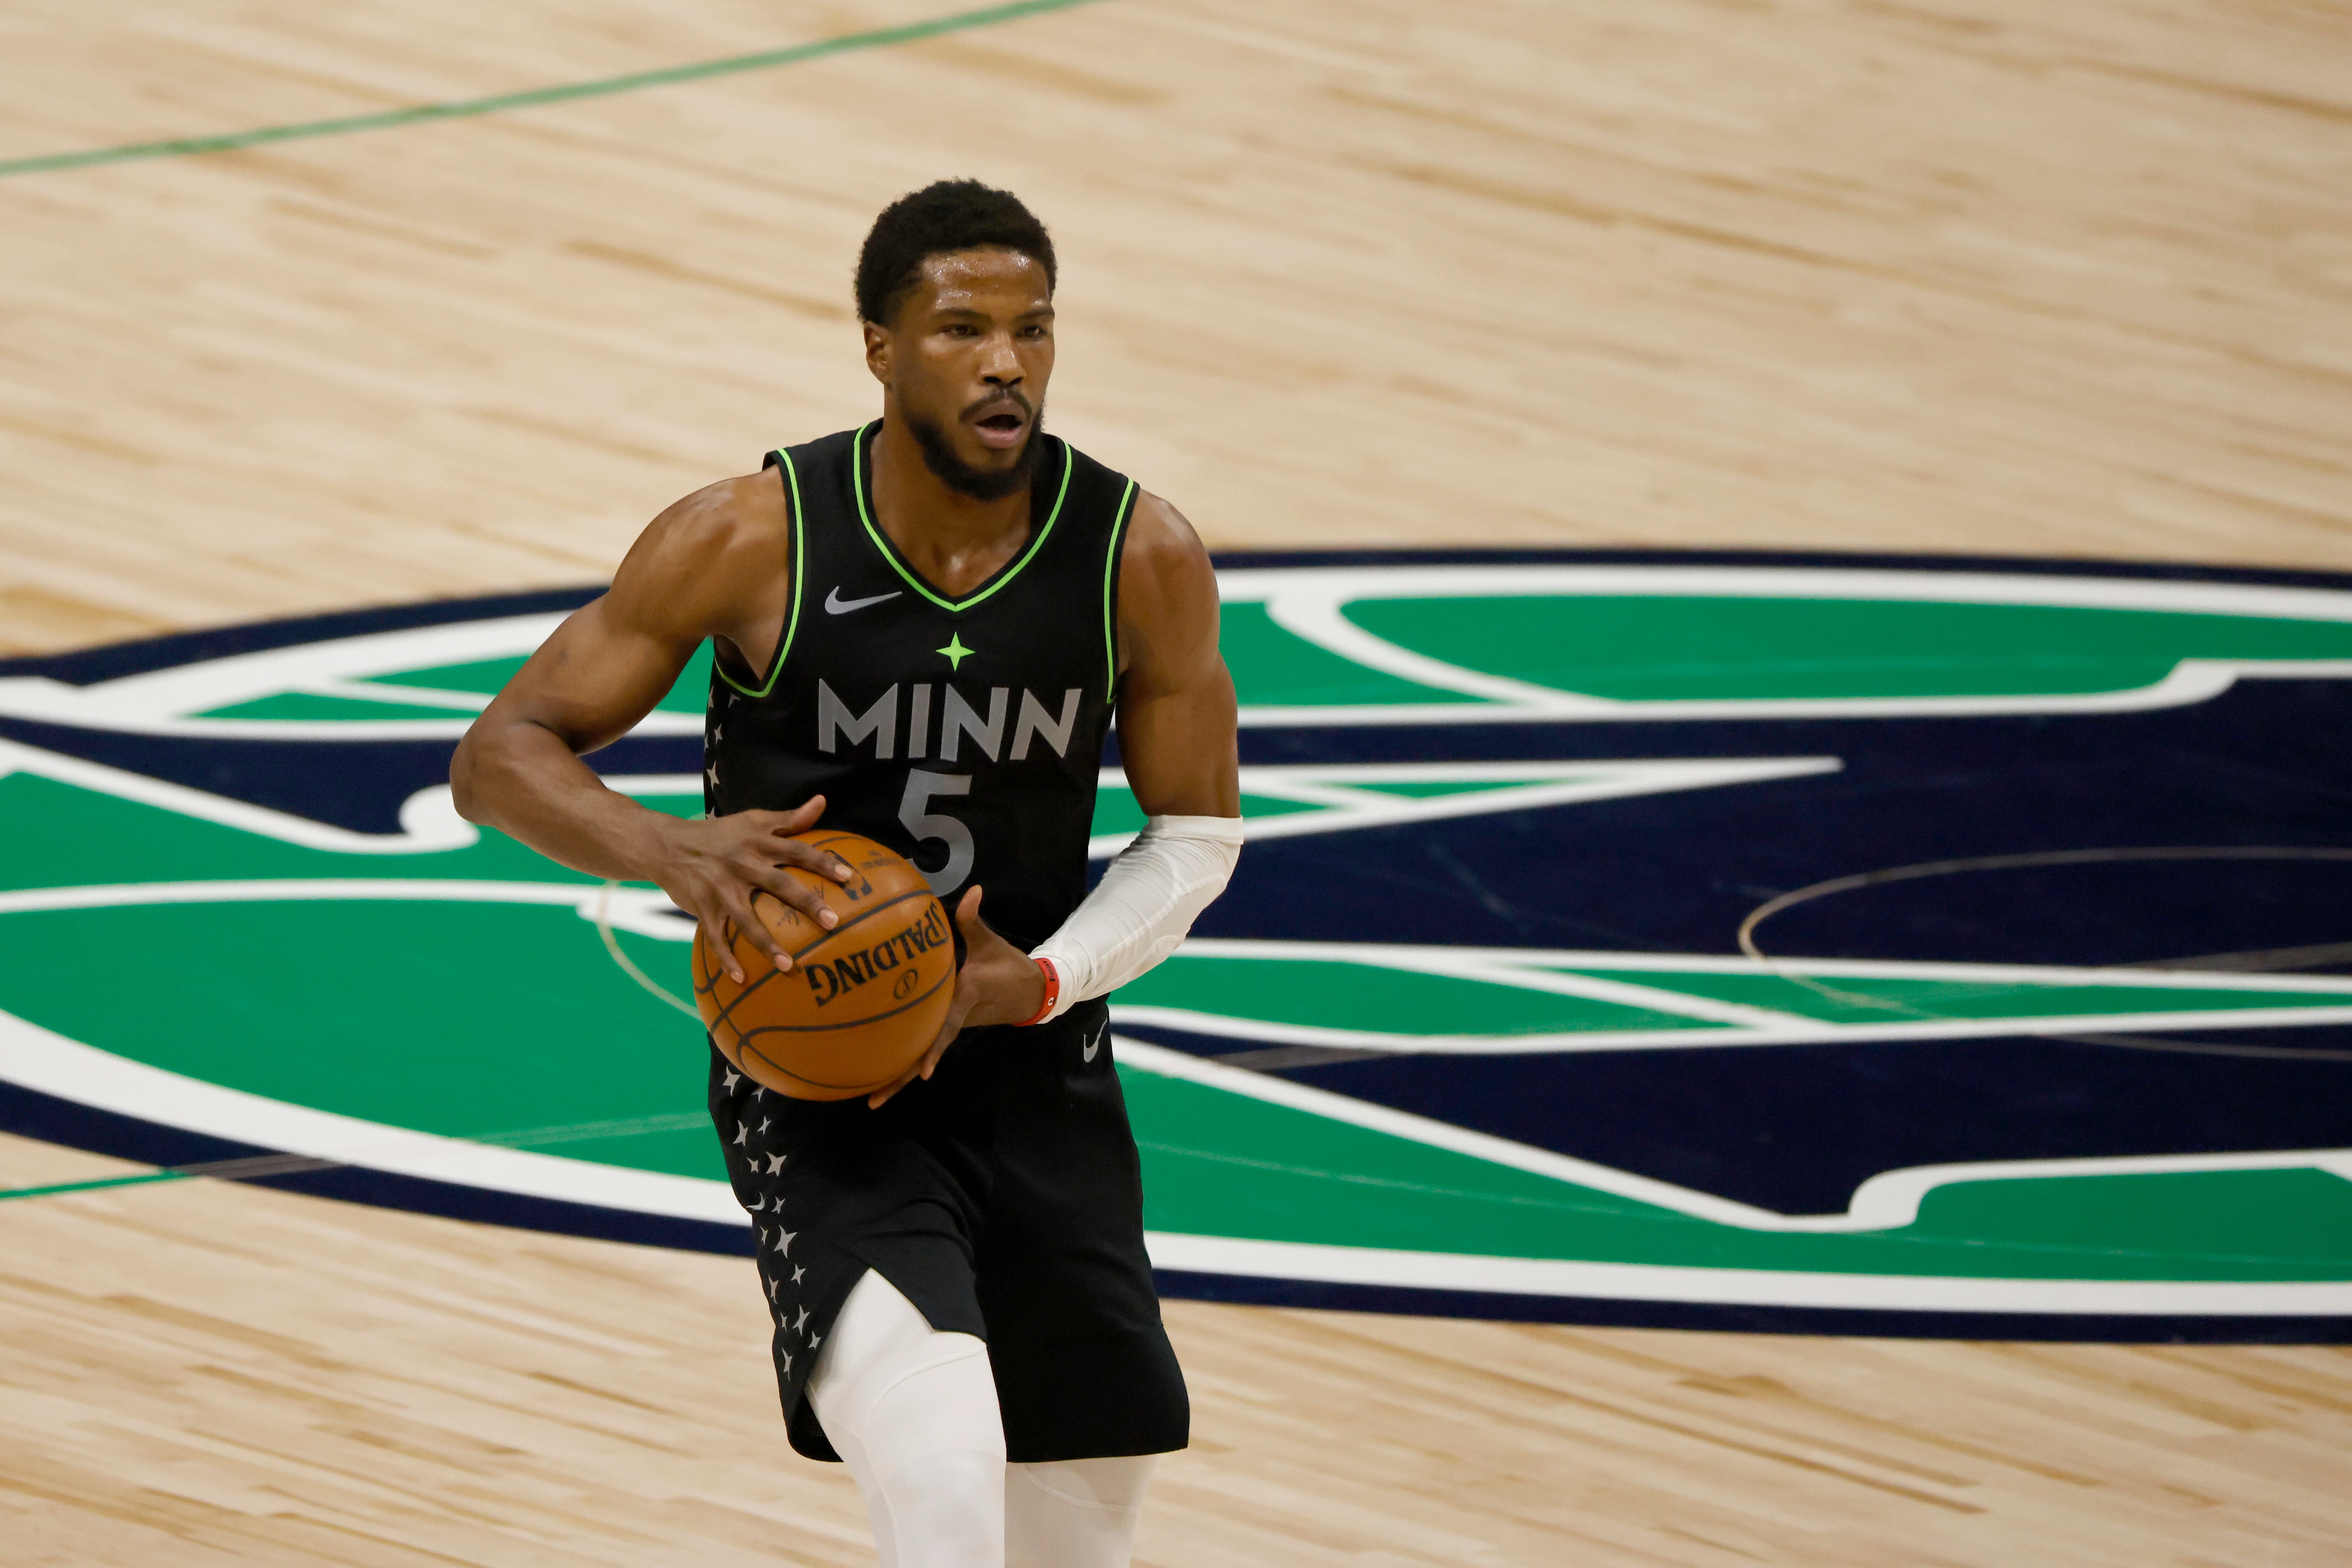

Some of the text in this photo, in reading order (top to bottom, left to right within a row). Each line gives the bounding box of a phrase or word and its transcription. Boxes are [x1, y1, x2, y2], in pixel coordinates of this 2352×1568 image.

[818, 678, 1082, 762] MINN
[898, 768, 975, 897] 5
[804, 901, 949, 1007] SPALDING
